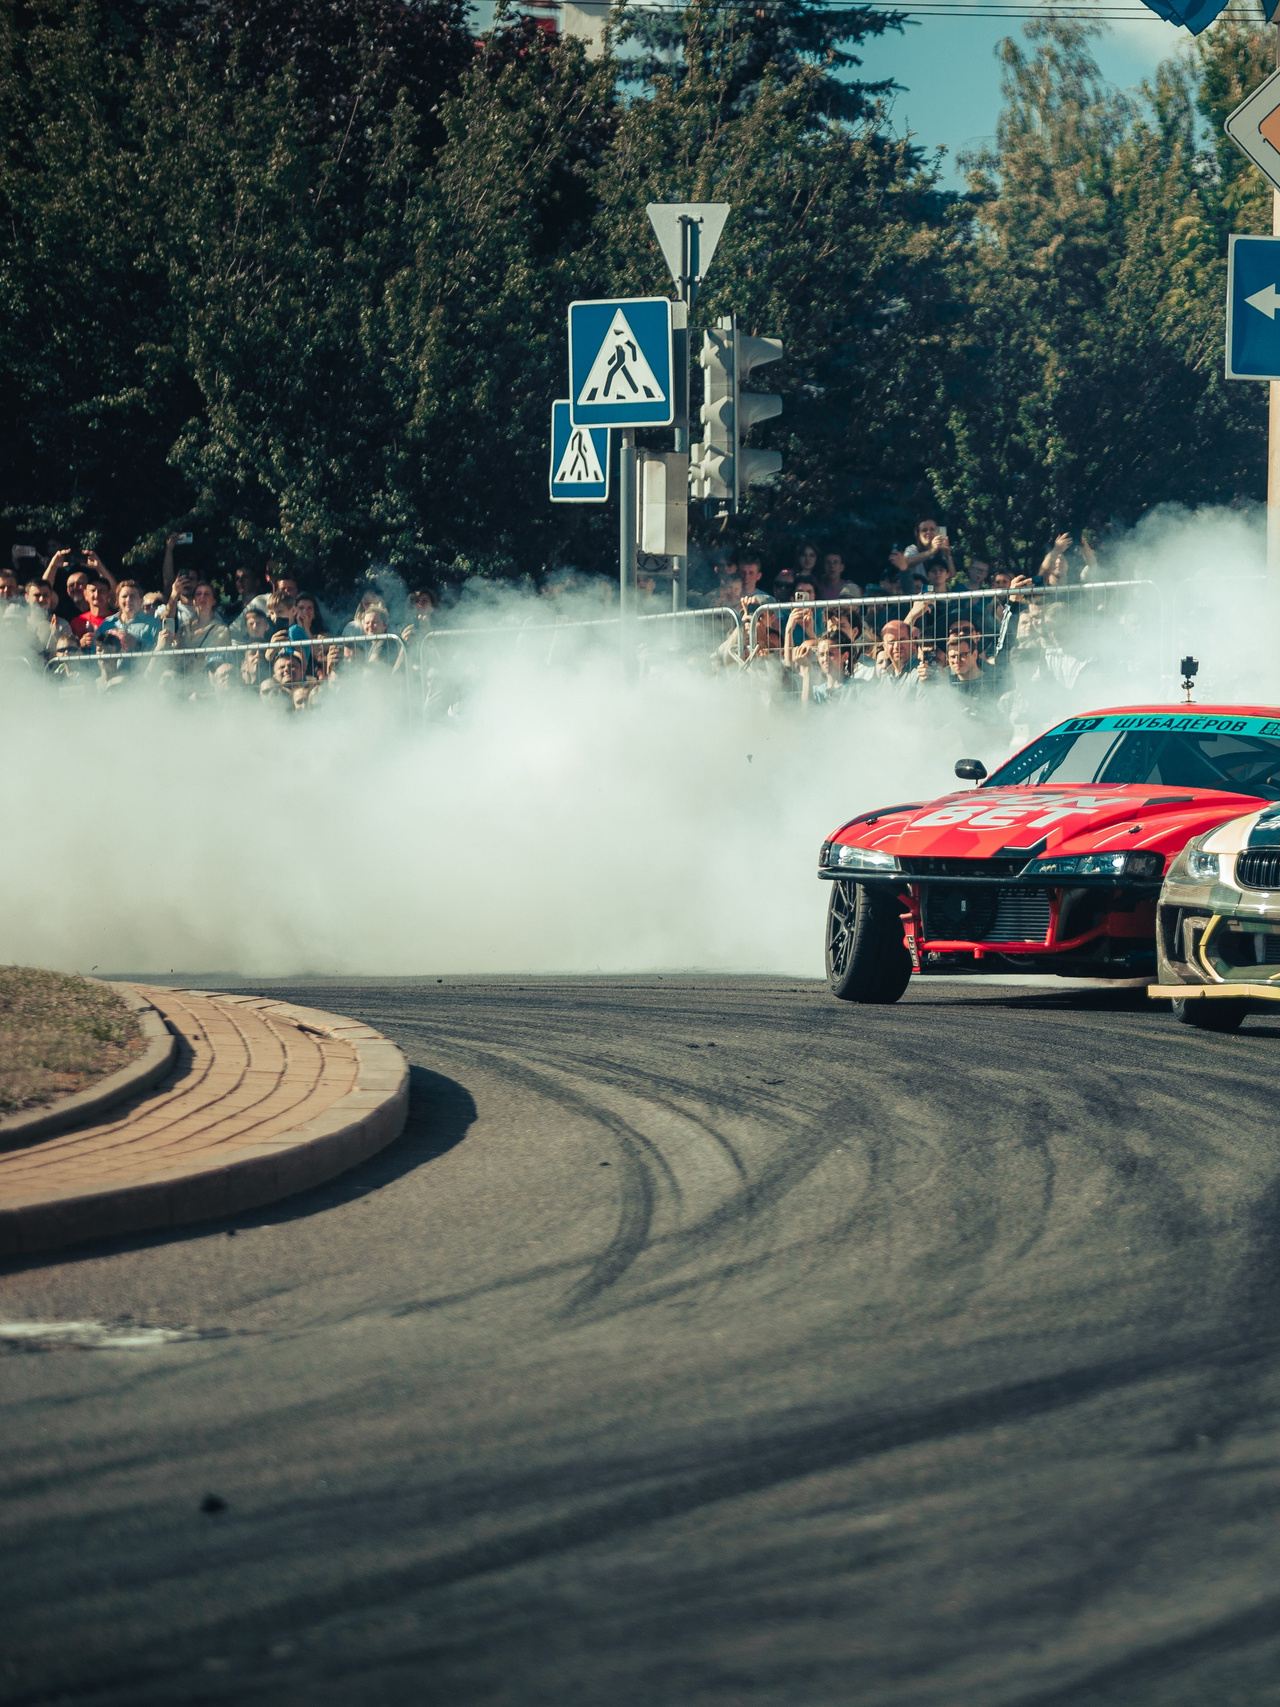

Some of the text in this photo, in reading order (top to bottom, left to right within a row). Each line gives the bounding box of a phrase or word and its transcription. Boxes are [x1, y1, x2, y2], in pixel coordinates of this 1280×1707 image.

[1075, 719, 1095, 730] 19
[1112, 716, 1248, 732] ШУБАДЁРОВ
[942, 794, 1132, 809] FON
[909, 805, 1100, 828] BET
